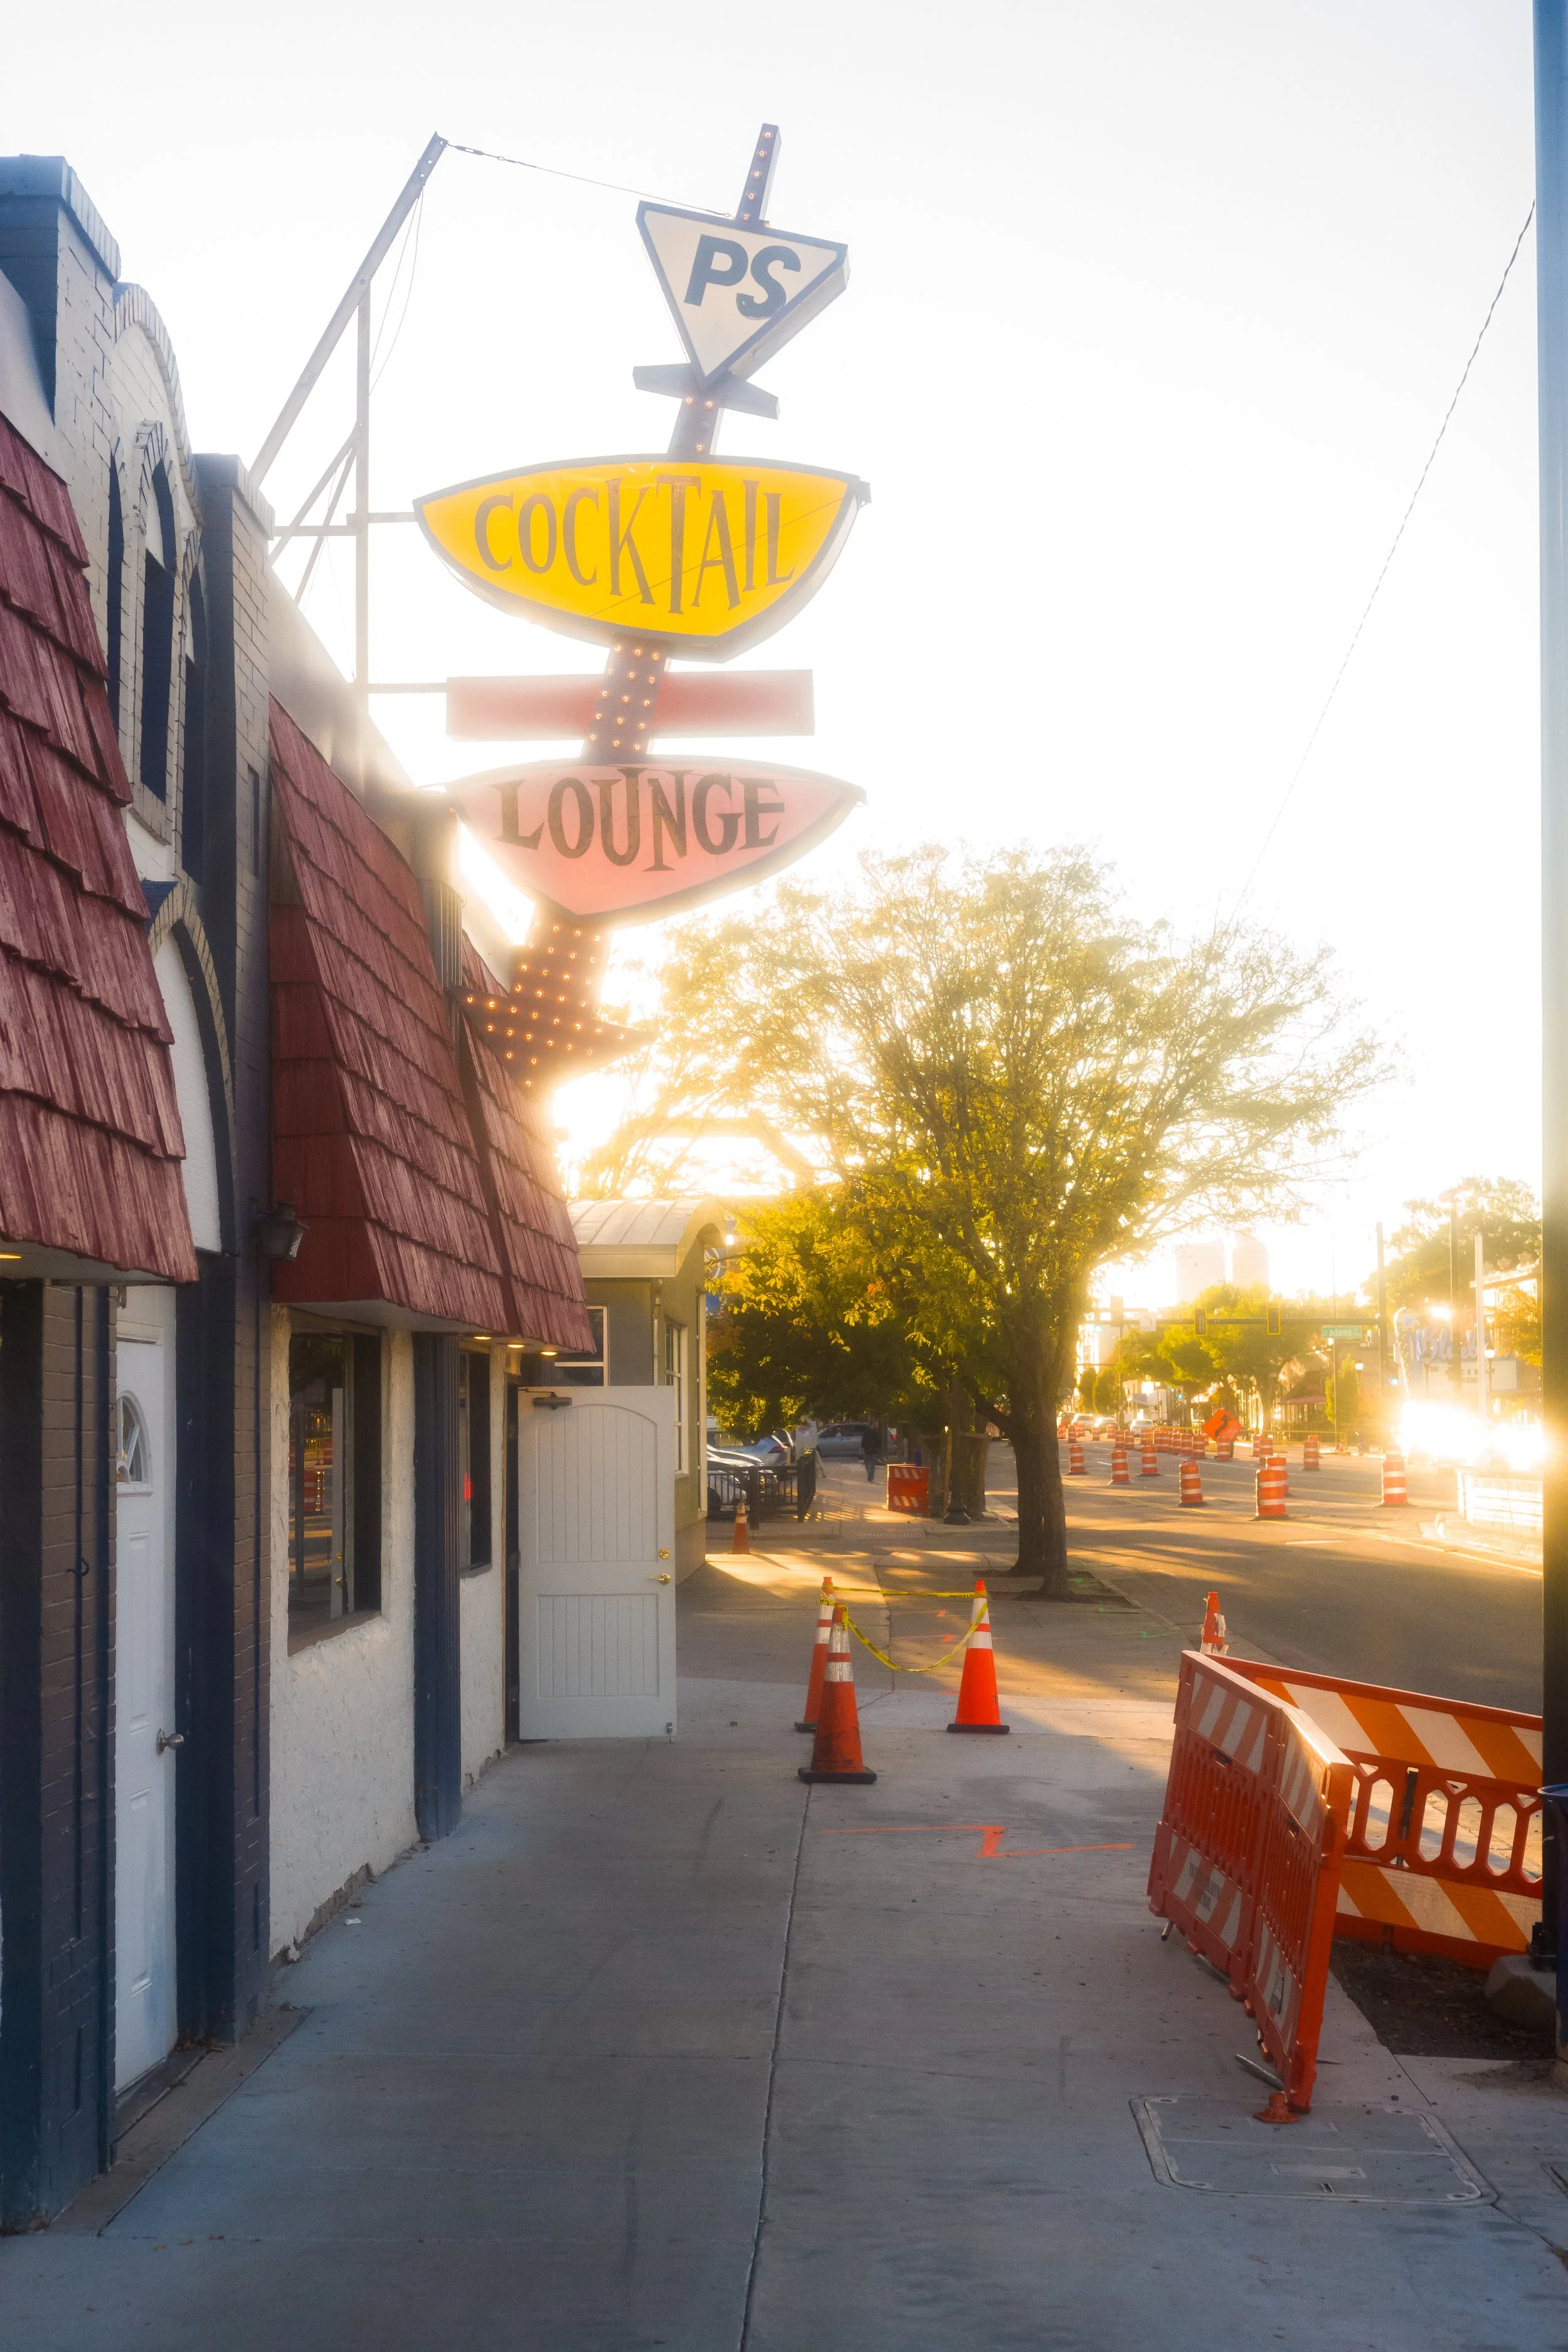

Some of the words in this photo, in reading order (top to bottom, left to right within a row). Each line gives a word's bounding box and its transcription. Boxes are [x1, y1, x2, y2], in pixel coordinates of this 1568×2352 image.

[684, 234, 802, 320] PS
[474, 474, 797, 615] COCKTAIL
[492, 766, 785, 872] LOUNGE
[1329, 1329, 1352, 1337] Adams
